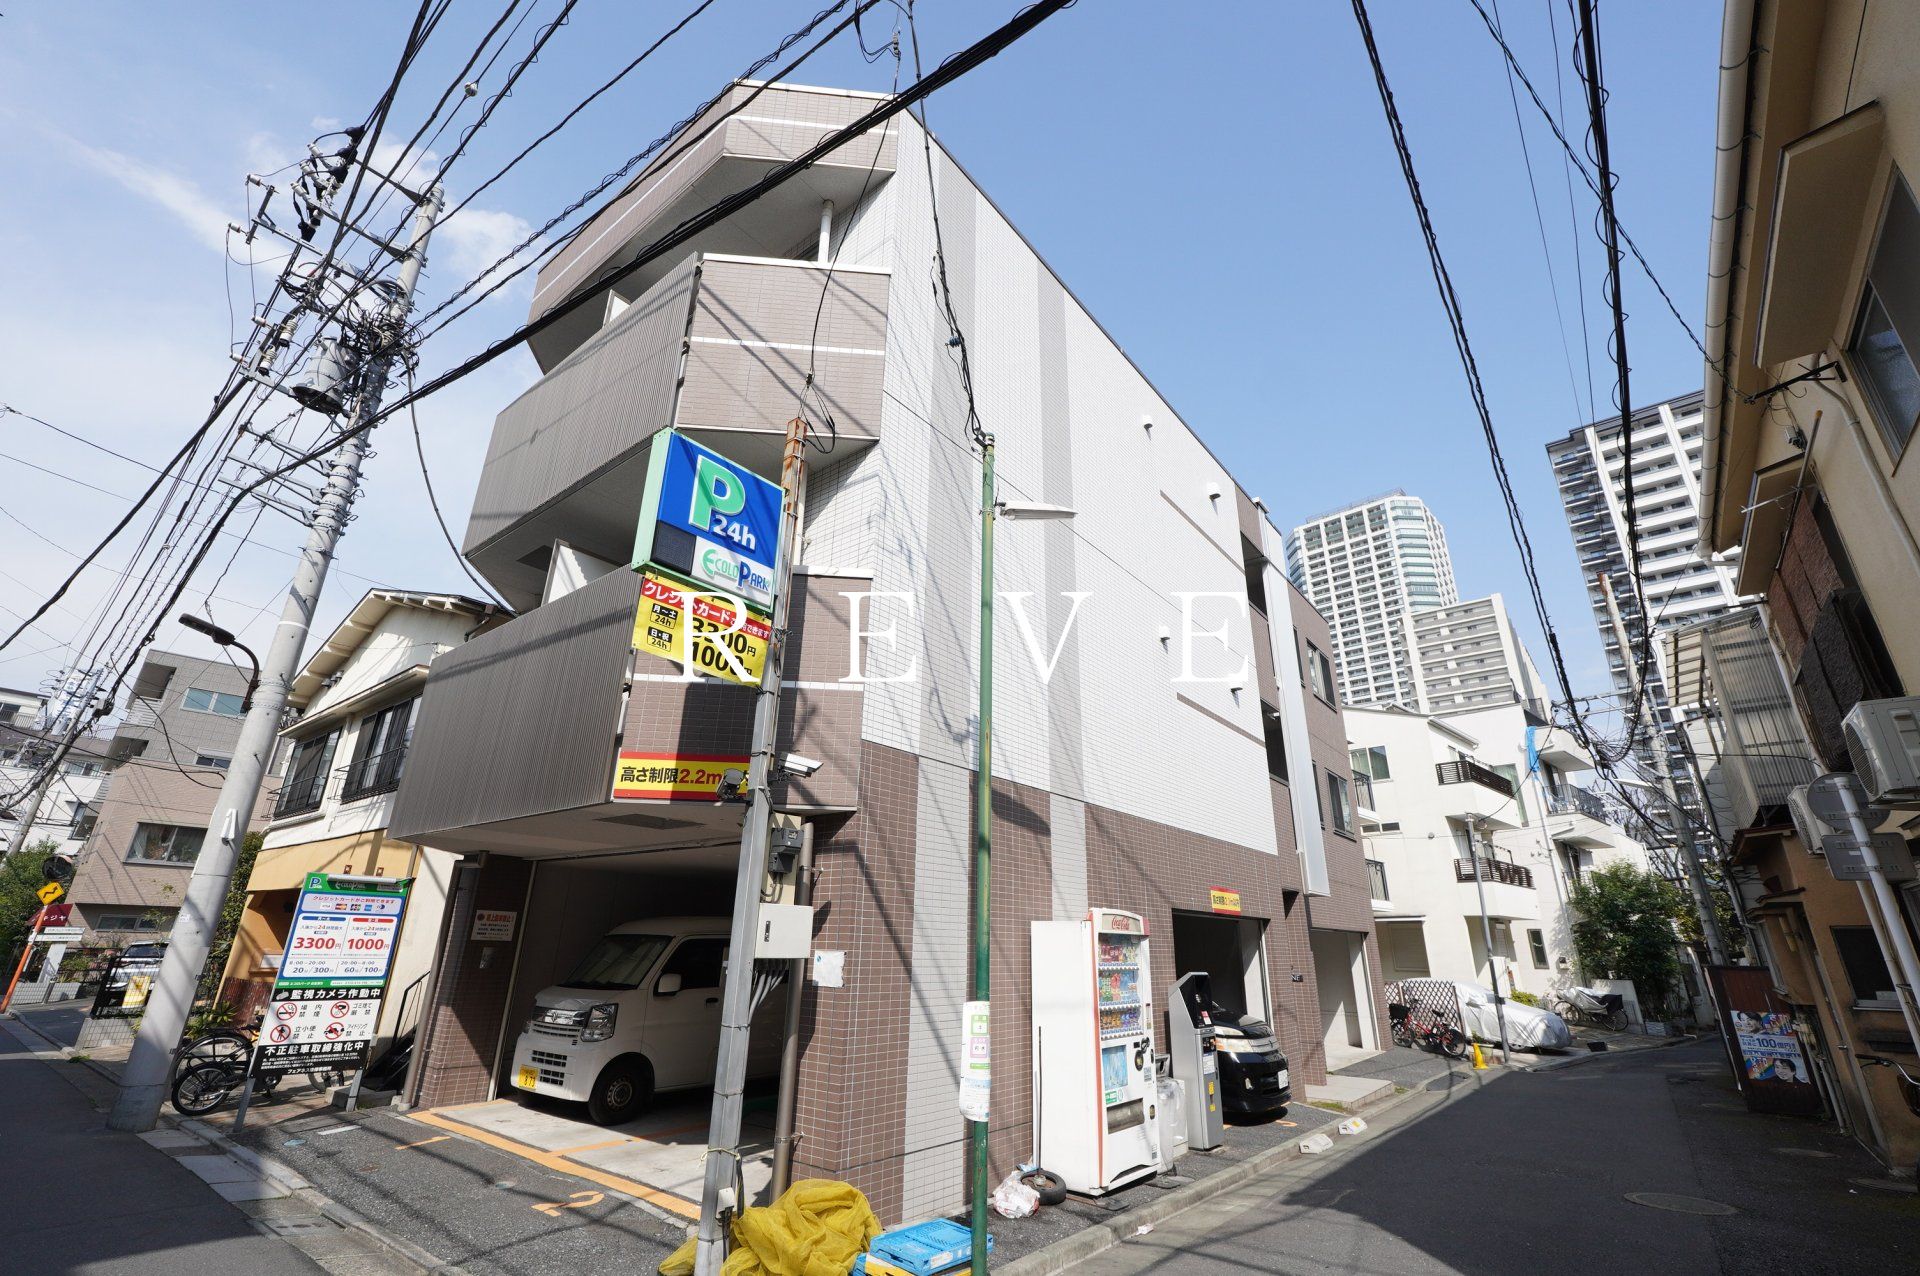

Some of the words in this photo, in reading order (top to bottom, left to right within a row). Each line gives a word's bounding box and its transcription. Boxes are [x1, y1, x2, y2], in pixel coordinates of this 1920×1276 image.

[688, 454, 746, 532] P
[713, 514, 756, 550] 24h
[654, 614, 672, 628] 24h
[651, 637, 668, 650] 24h
[620, 766, 750, 786] 高さ制限2.2m
[294, 937, 341, 950] 3300円
[347, 938, 390, 951] 1000円
[290, 988, 381, 1000] 監視カメラ作動中
[264, 1041, 365, 1057] 不正駐車取締強化中
